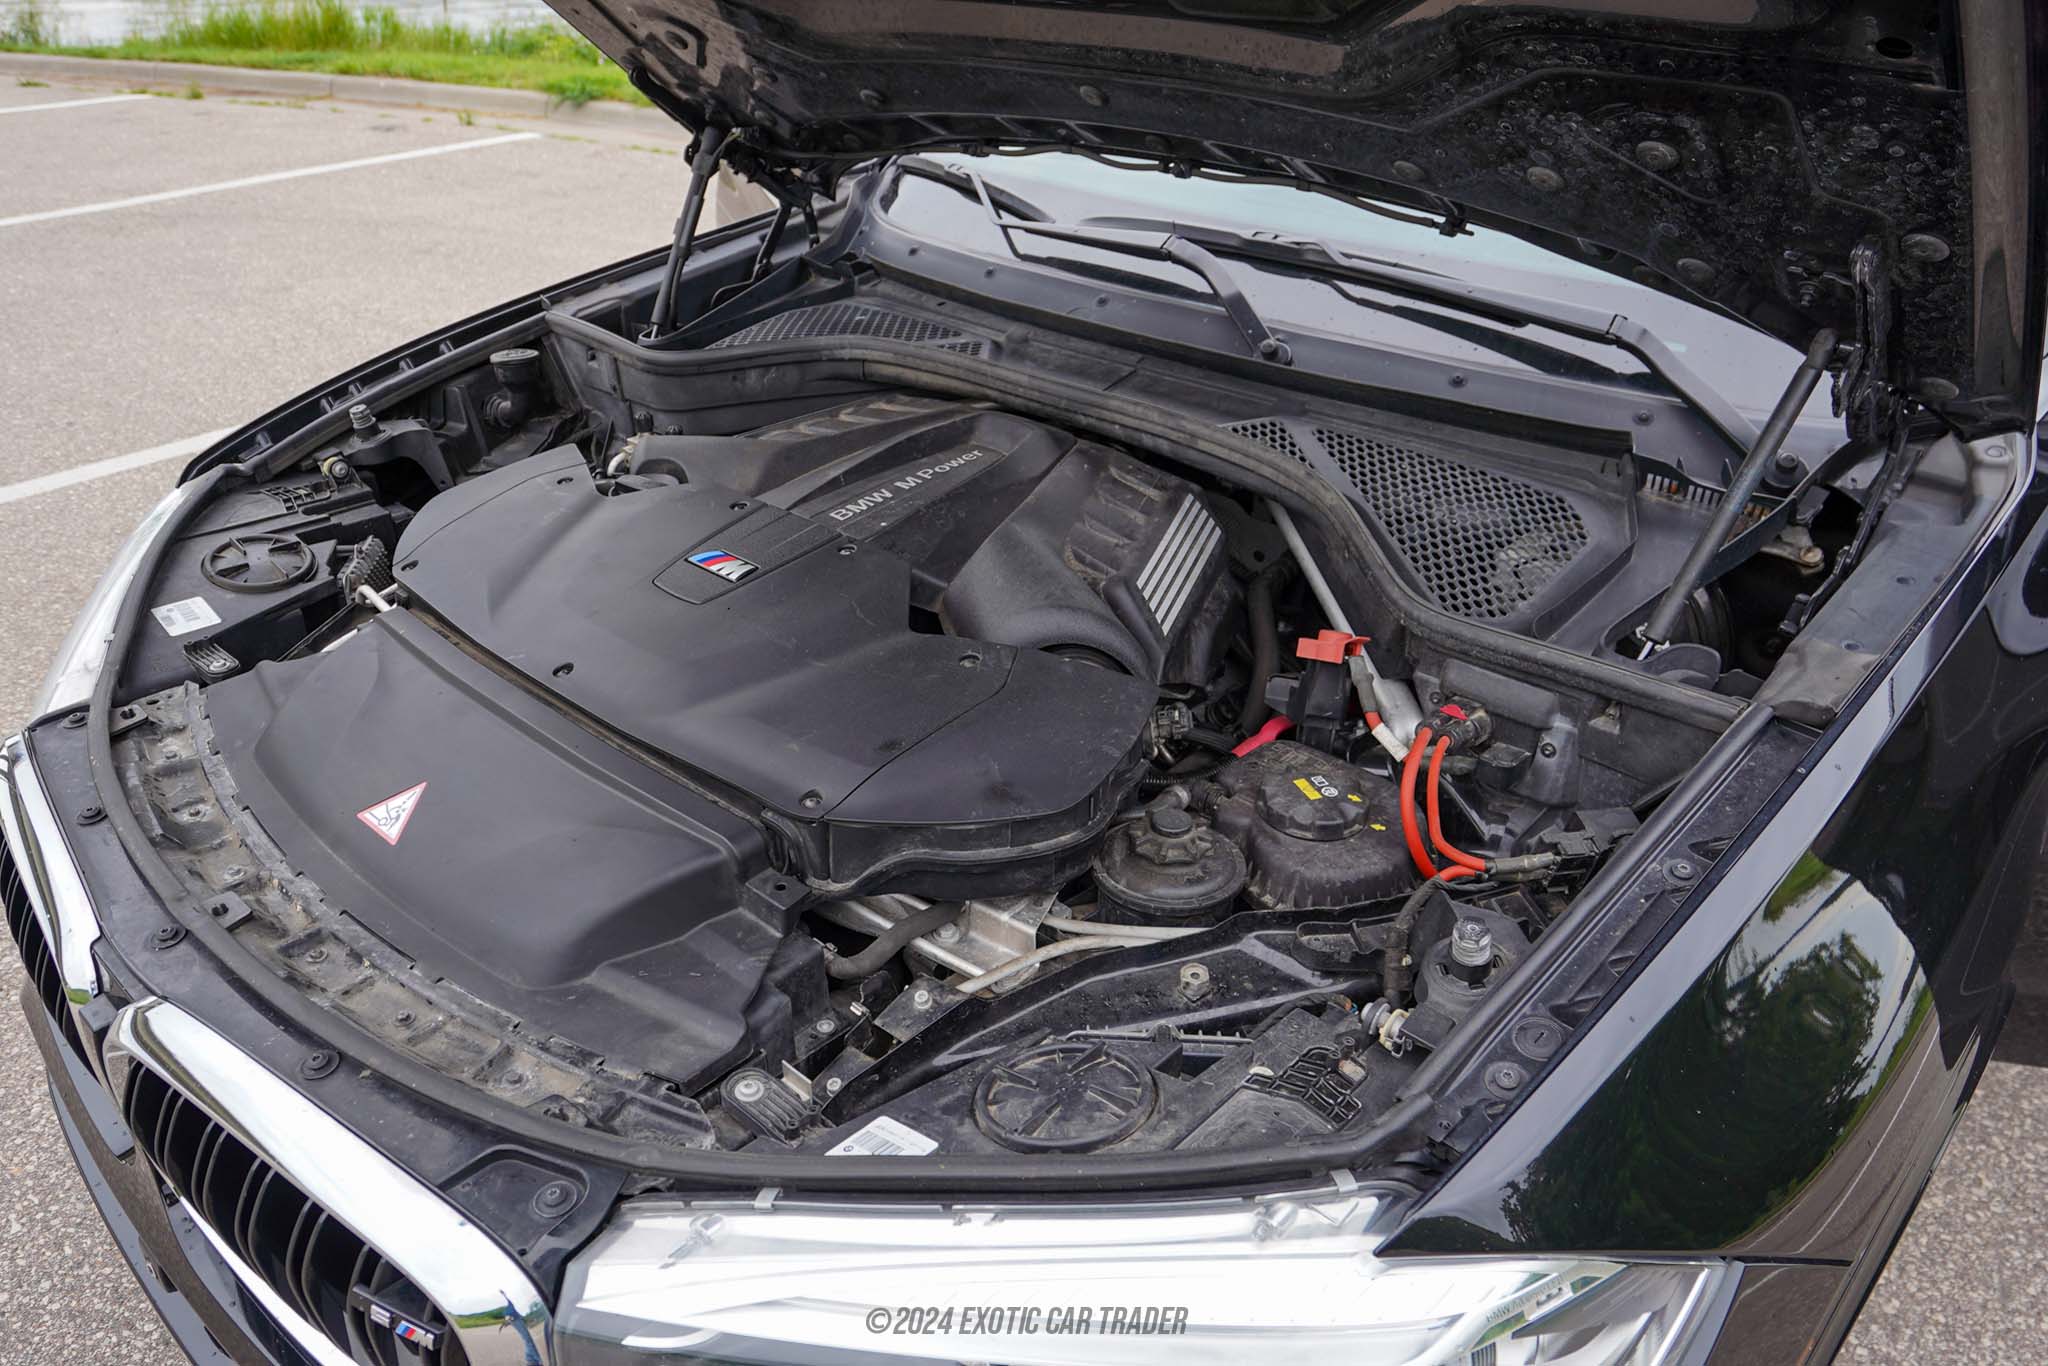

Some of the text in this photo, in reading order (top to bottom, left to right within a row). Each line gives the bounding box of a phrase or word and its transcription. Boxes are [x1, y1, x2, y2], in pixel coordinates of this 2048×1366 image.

[829, 449, 984, 521] BMW M Power
